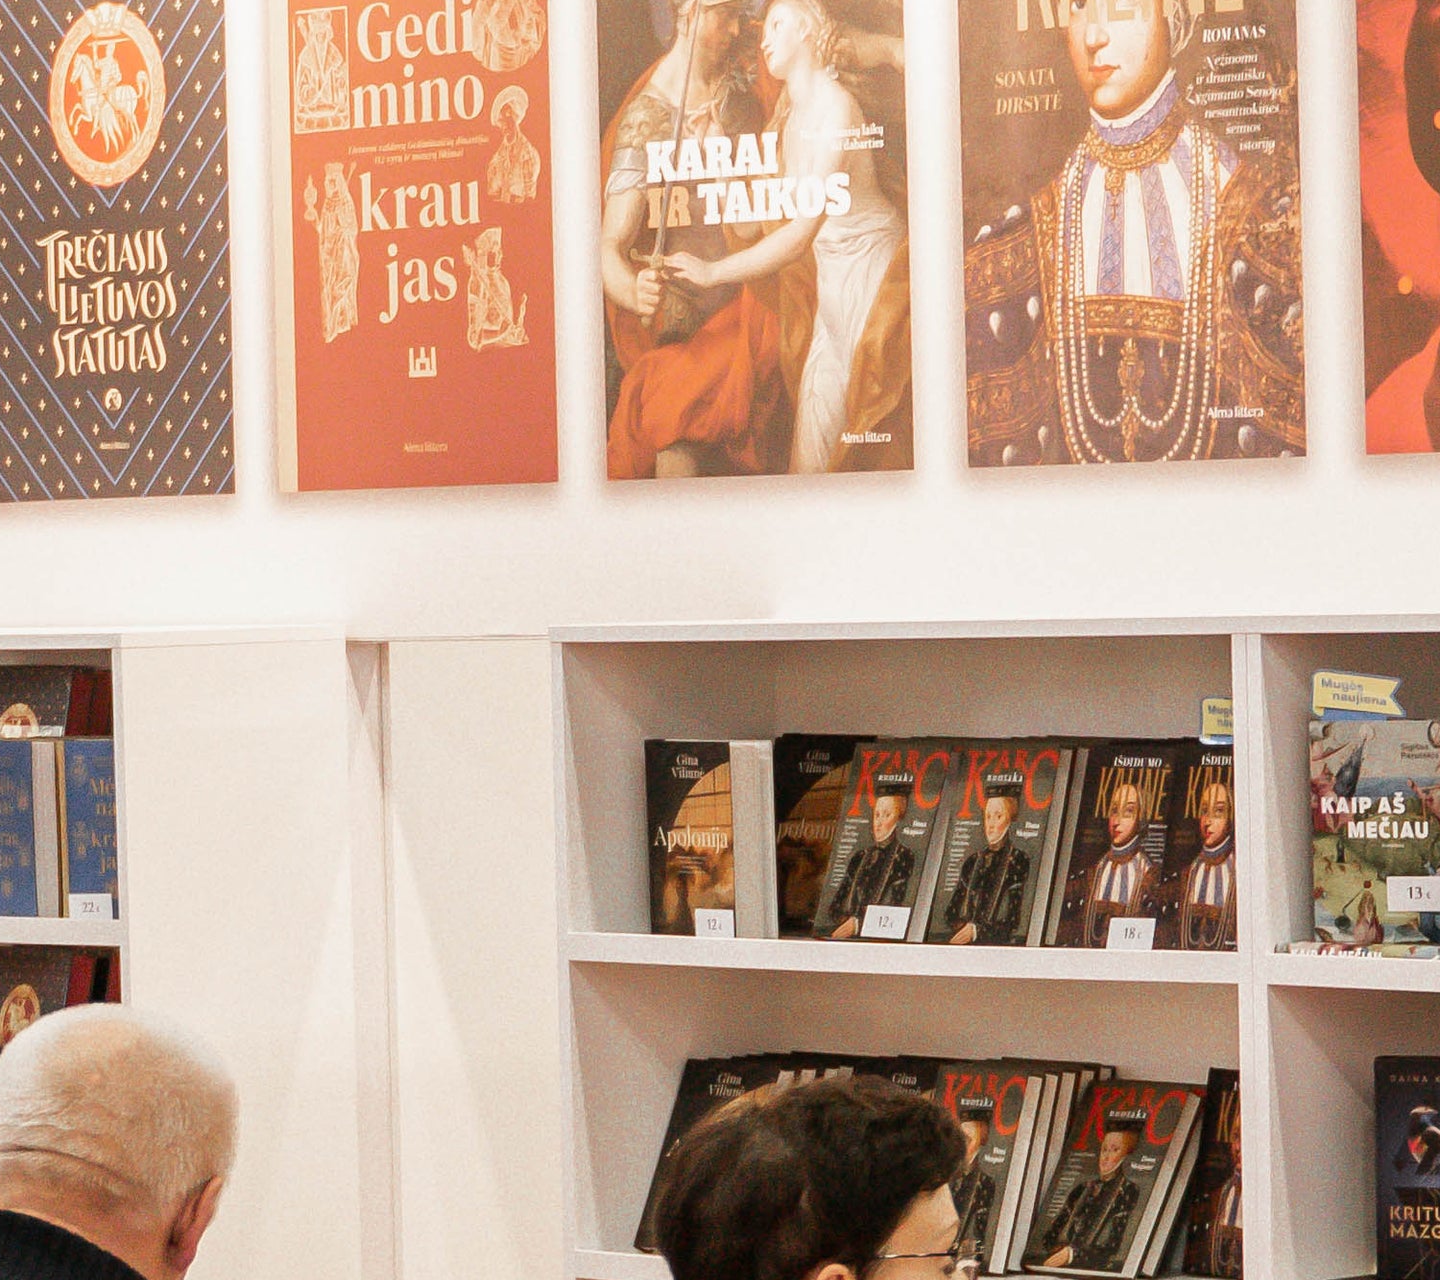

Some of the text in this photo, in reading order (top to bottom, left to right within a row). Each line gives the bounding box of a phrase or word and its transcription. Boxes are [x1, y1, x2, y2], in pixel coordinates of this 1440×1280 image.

[1202, 24, 1267, 43] ROMANAS
[994, 67, 1056, 90] SONATA
[350, 64, 485, 131] mino
[994, 89, 1062, 116] DIRSYTĖ
[645, 130, 779, 184] KARAI
[359, 171, 480, 234] krau
[647, 171, 852, 229] IR TAIKOS
[36, 228, 170, 312] TREČIASIS
[379, 245, 458, 324] jas
[56, 275, 178, 327] LIETUVOS
[52, 322, 168, 379] STATUTAS
[1207, 407, 1233, 419] Alma
[839, 432, 863, 445] Alma
[676, 752, 699, 767] Gina
[1114, 753, 1163, 768] IŠDIDUMO
[1321, 791, 1406, 815] KAIP AŠ
[654, 824, 729, 854] Apolonija
[1347, 816, 1429, 839] MEČIAU
